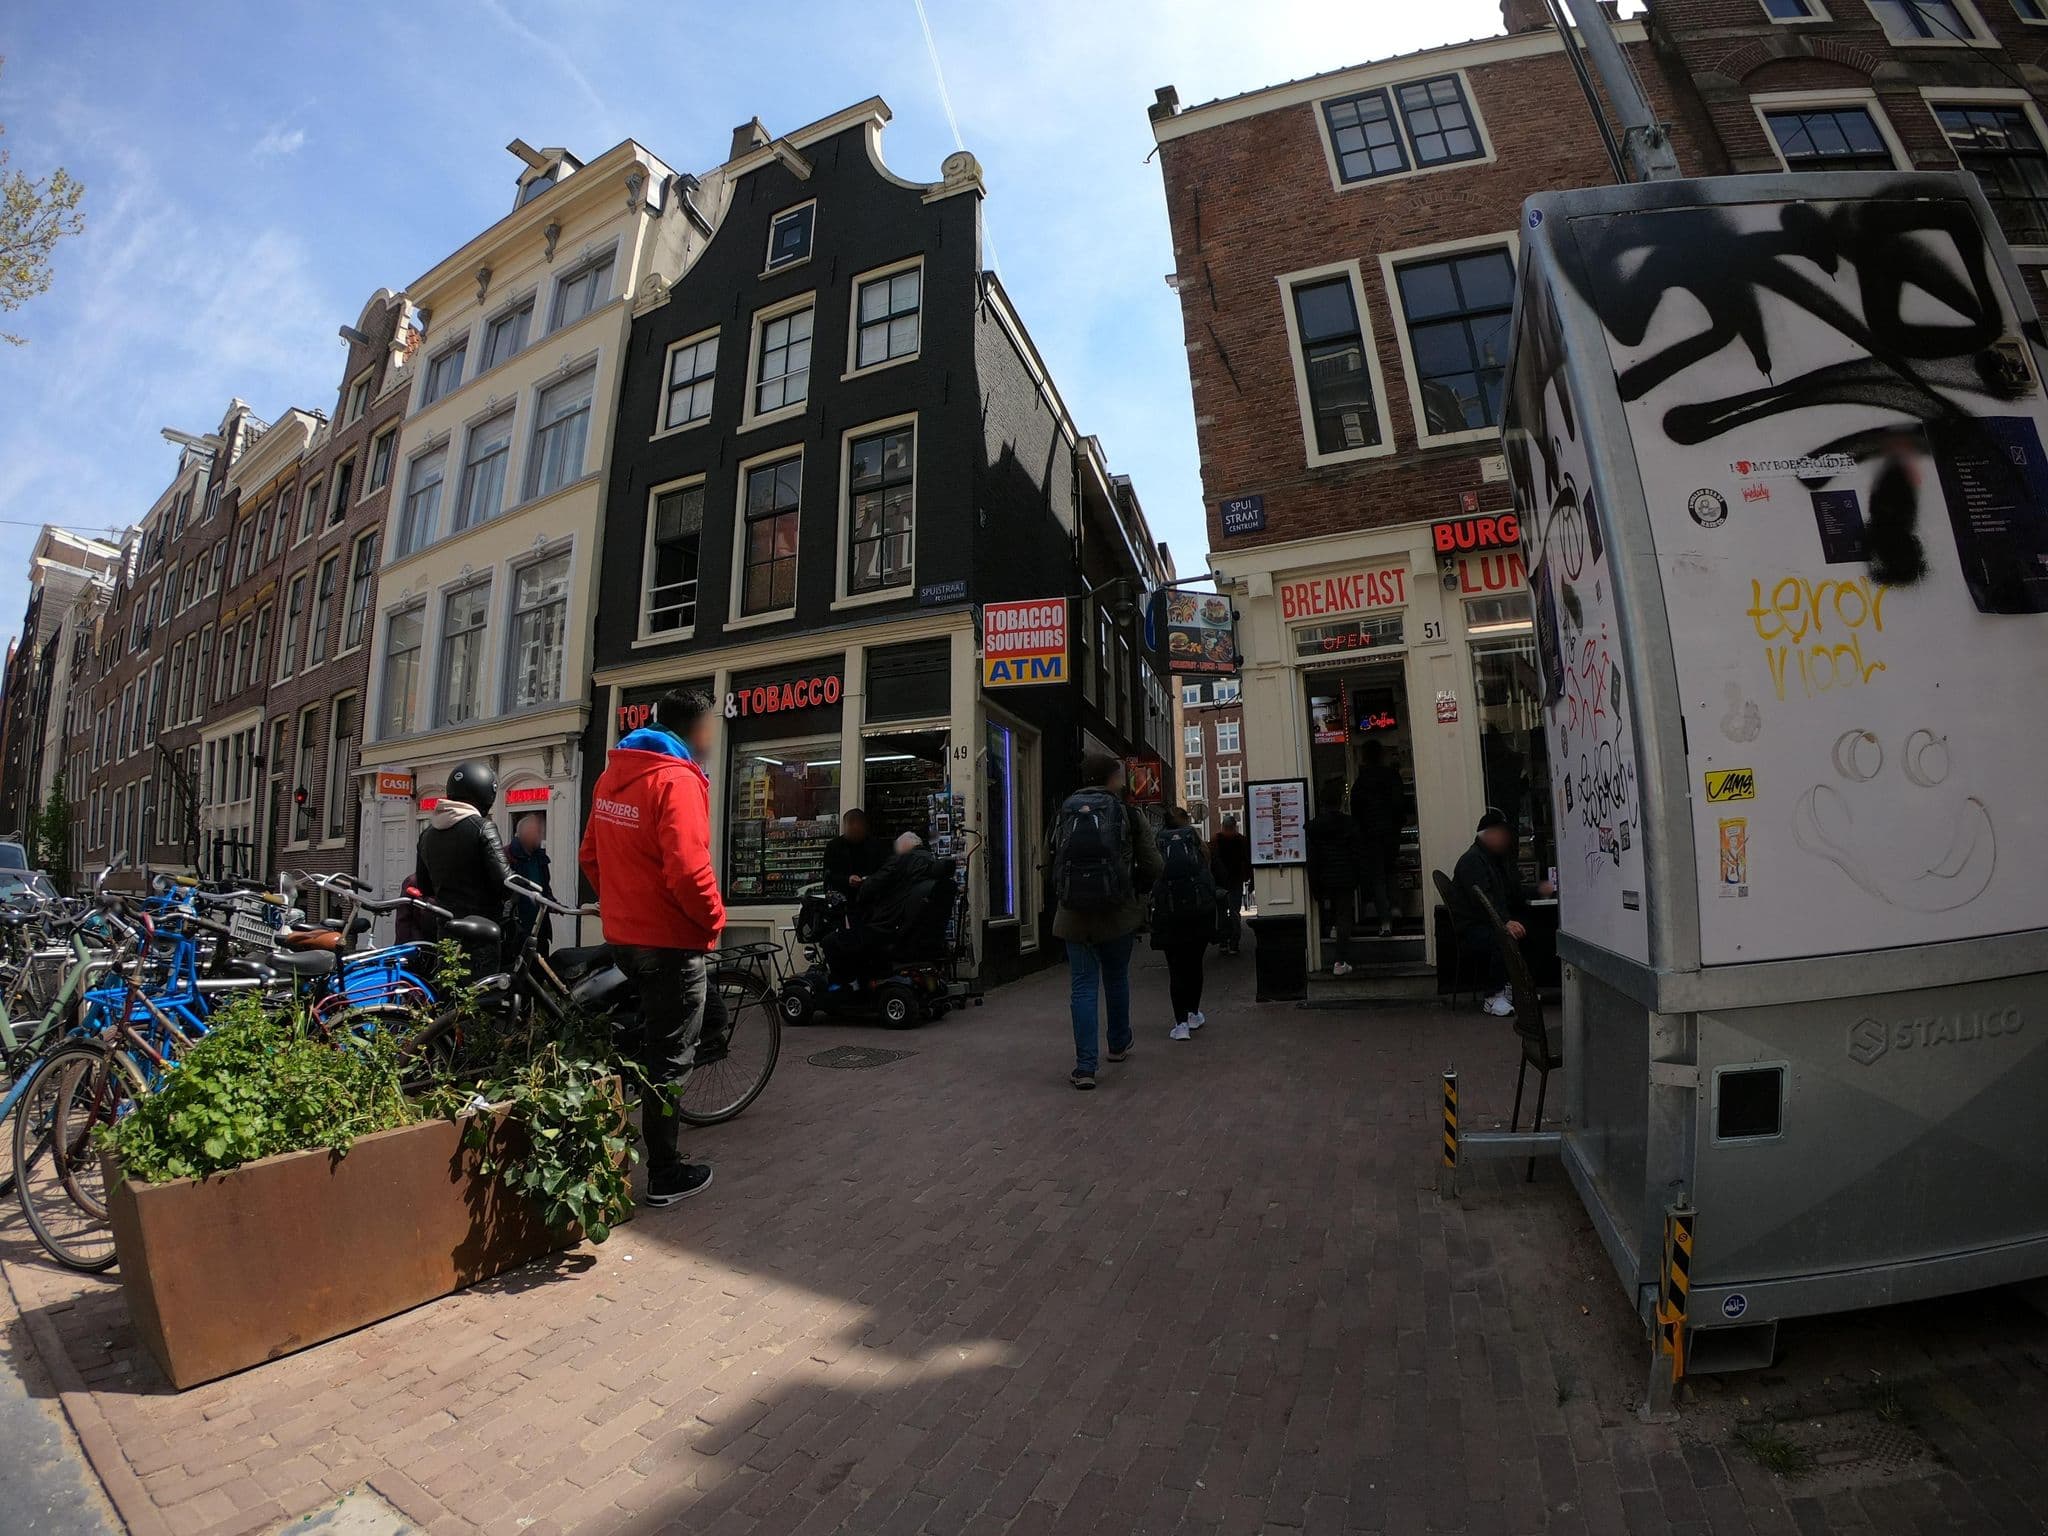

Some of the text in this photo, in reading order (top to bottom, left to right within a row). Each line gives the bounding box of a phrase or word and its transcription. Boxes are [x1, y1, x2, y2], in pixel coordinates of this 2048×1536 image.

[1230, 499, 1252, 512] SPUI
[1225, 509, 1259, 525] STRAAT
[1229, 521, 1259, 532] CENTRUM
[1434, 515, 1520, 552] BURG
[921, 582, 965, 597] SPUISTRAAT
[1280, 568, 1406, 619] BREAKFAST
[986, 605, 1064, 632] TOBACCO
[1424, 621, 1441, 639] 51
[986, 629, 1065, 652] SOUVENIRS
[1323, 632, 1372, 650] OPEN
[990, 656, 1062, 682] ATM
[953, 745, 968, 760] 49
[382, 778, 410, 790] CASH
[1893, 1010, 2025, 1050] STALICO
